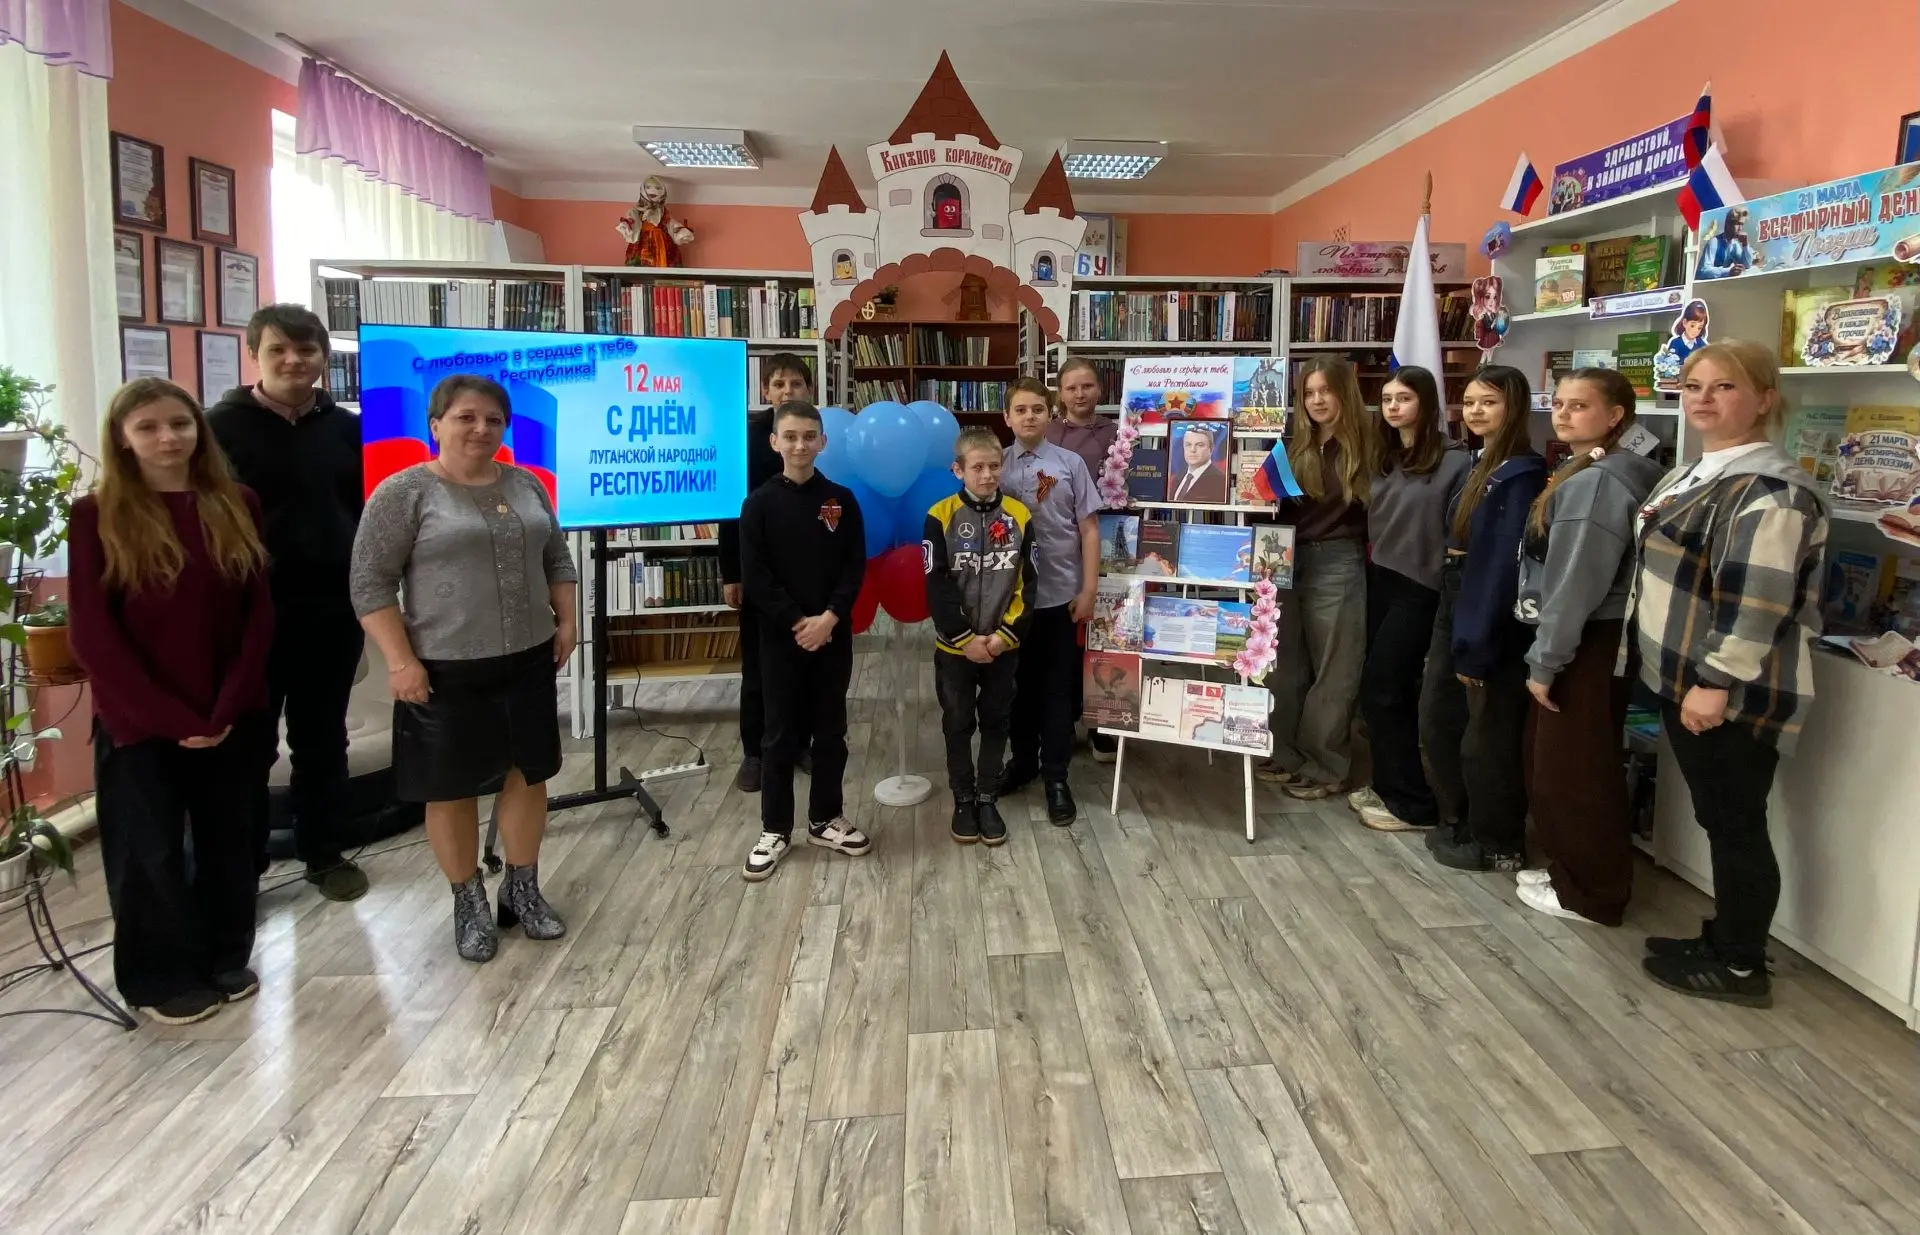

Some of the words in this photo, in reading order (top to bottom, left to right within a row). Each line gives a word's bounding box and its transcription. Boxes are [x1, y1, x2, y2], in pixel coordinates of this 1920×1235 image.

[1604, 126, 1672, 168] ЗДРАВСТВУЙ,
[1587, 175, 1594, 191] К
[1596, 159, 1643, 188] ЗНАНИЯМ
[1645, 143, 1685, 174] ДОРОГА
[1798, 192, 1814, 209] 21
[1817, 180, 1862, 204] МАРТА
[1759, 195, 1871, 242] ВСЕМИРНЫЙ
[1878, 188, 1920, 223] ДЕН
[1312, 263, 1381, 273] любовных
[1169, 293, 1177, 304] Б
[1562, 290, 1576, 302] 100
[1832, 308, 1880, 320] Вдохновение
[1844, 318, 1870, 328] каждой
[1838, 329, 1866, 340] строчке
[412, 357, 424, 370] С
[429, 350, 508, 368] любовью
[513, 348, 521, 361] в
[527, 343, 583, 359] сердце
[587, 343, 596, 353] к
[1619, 358, 1653, 367] СЛОВАРЬ
[500, 360, 597, 382] Республика!
[1142, 364, 1171, 374] любовью
[1180, 363, 1202, 376] сердце
[624, 363, 649, 393] 12
[653, 376, 681, 393] МАЯ
[606, 404, 623, 436] С
[628, 399, 696, 442] ДНЁМ
[1870, 434, 1880, 444] 21
[1882, 435, 1908, 447] МАРТА
[589, 446, 656, 465] ЛУГАНСКОЙ
[658, 445, 717, 465] НАРОДНОЙ
[1864, 448, 1907, 460] ВСЕМИРНЫЙ
[1853, 456, 1875, 466] ДЕНЬ
[1876, 457, 1913, 470] ПОЭЗИИ
[590, 469, 717, 496] РЕСПУБЛИКИ!
